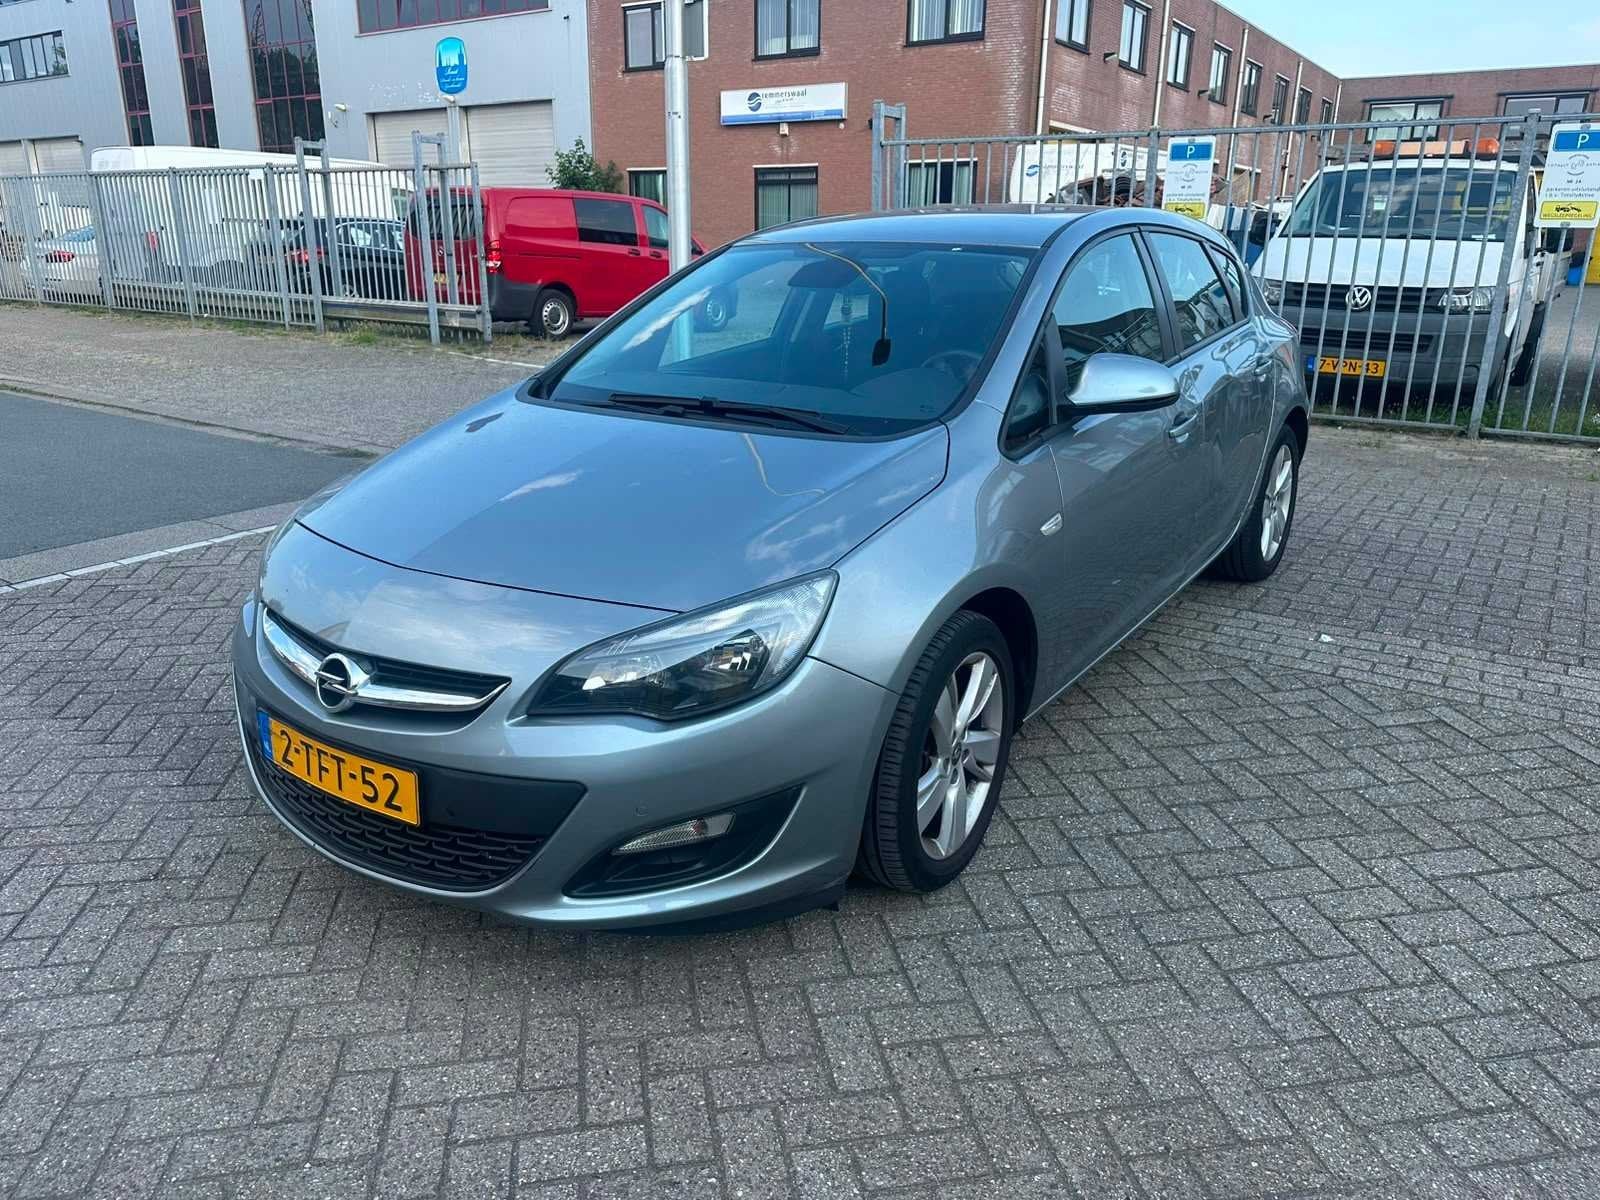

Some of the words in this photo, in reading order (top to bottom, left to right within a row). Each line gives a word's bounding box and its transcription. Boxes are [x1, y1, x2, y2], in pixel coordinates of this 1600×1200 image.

[1577, 133, 1590, 148] P
[1187, 145, 1196, 158] P
[279, 729, 403, 813] 2-TFT-52
